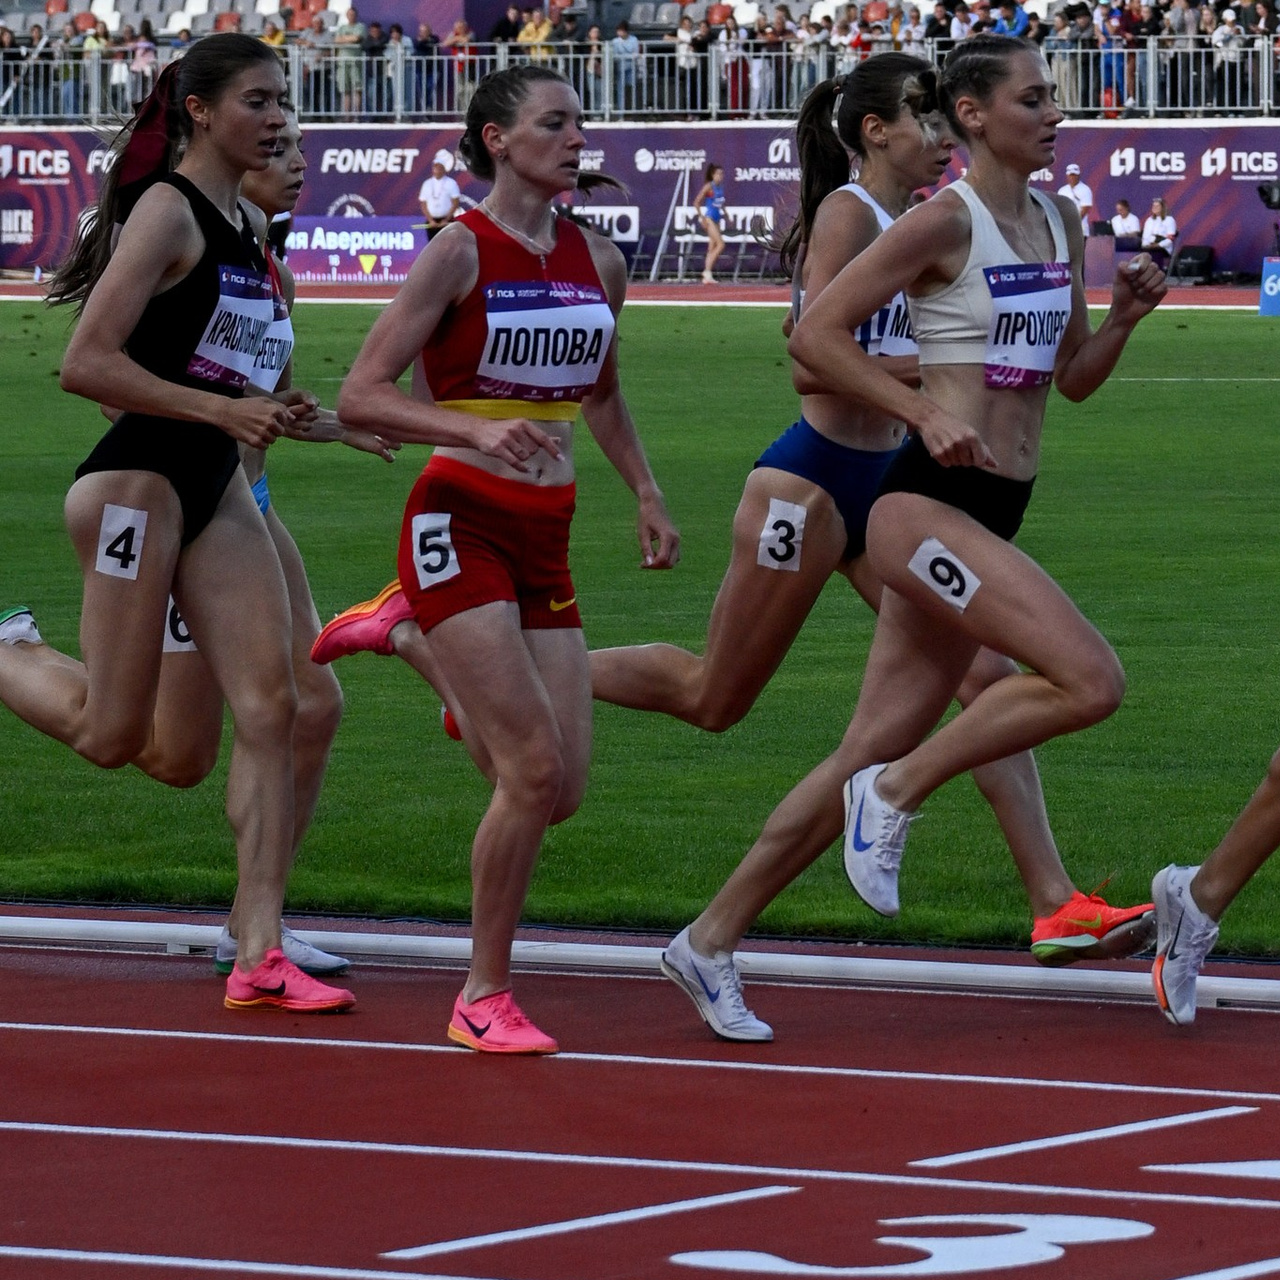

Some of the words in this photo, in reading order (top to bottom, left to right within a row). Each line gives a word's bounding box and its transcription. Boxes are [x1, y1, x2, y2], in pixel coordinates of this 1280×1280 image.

[17, 149, 70, 175] ПСБ
[320, 148, 419, 173] FONBET
[1139, 151, 1186, 173] ПСБ
[1231, 151, 1278, 173] ПСБ
[310, 226, 415, 256] Аверкина
[230, 275, 246, 284] ПСБ
[497, 289, 515, 298] ПСБ
[487, 327, 603, 367] ПОПОВА
[105, 526, 136, 569] 4
[419, 530, 450, 574] 5
[767, 519, 796, 562] 3
[928, 556, 966, 598] 9
[669, 1213, 1156, 1277] 3
